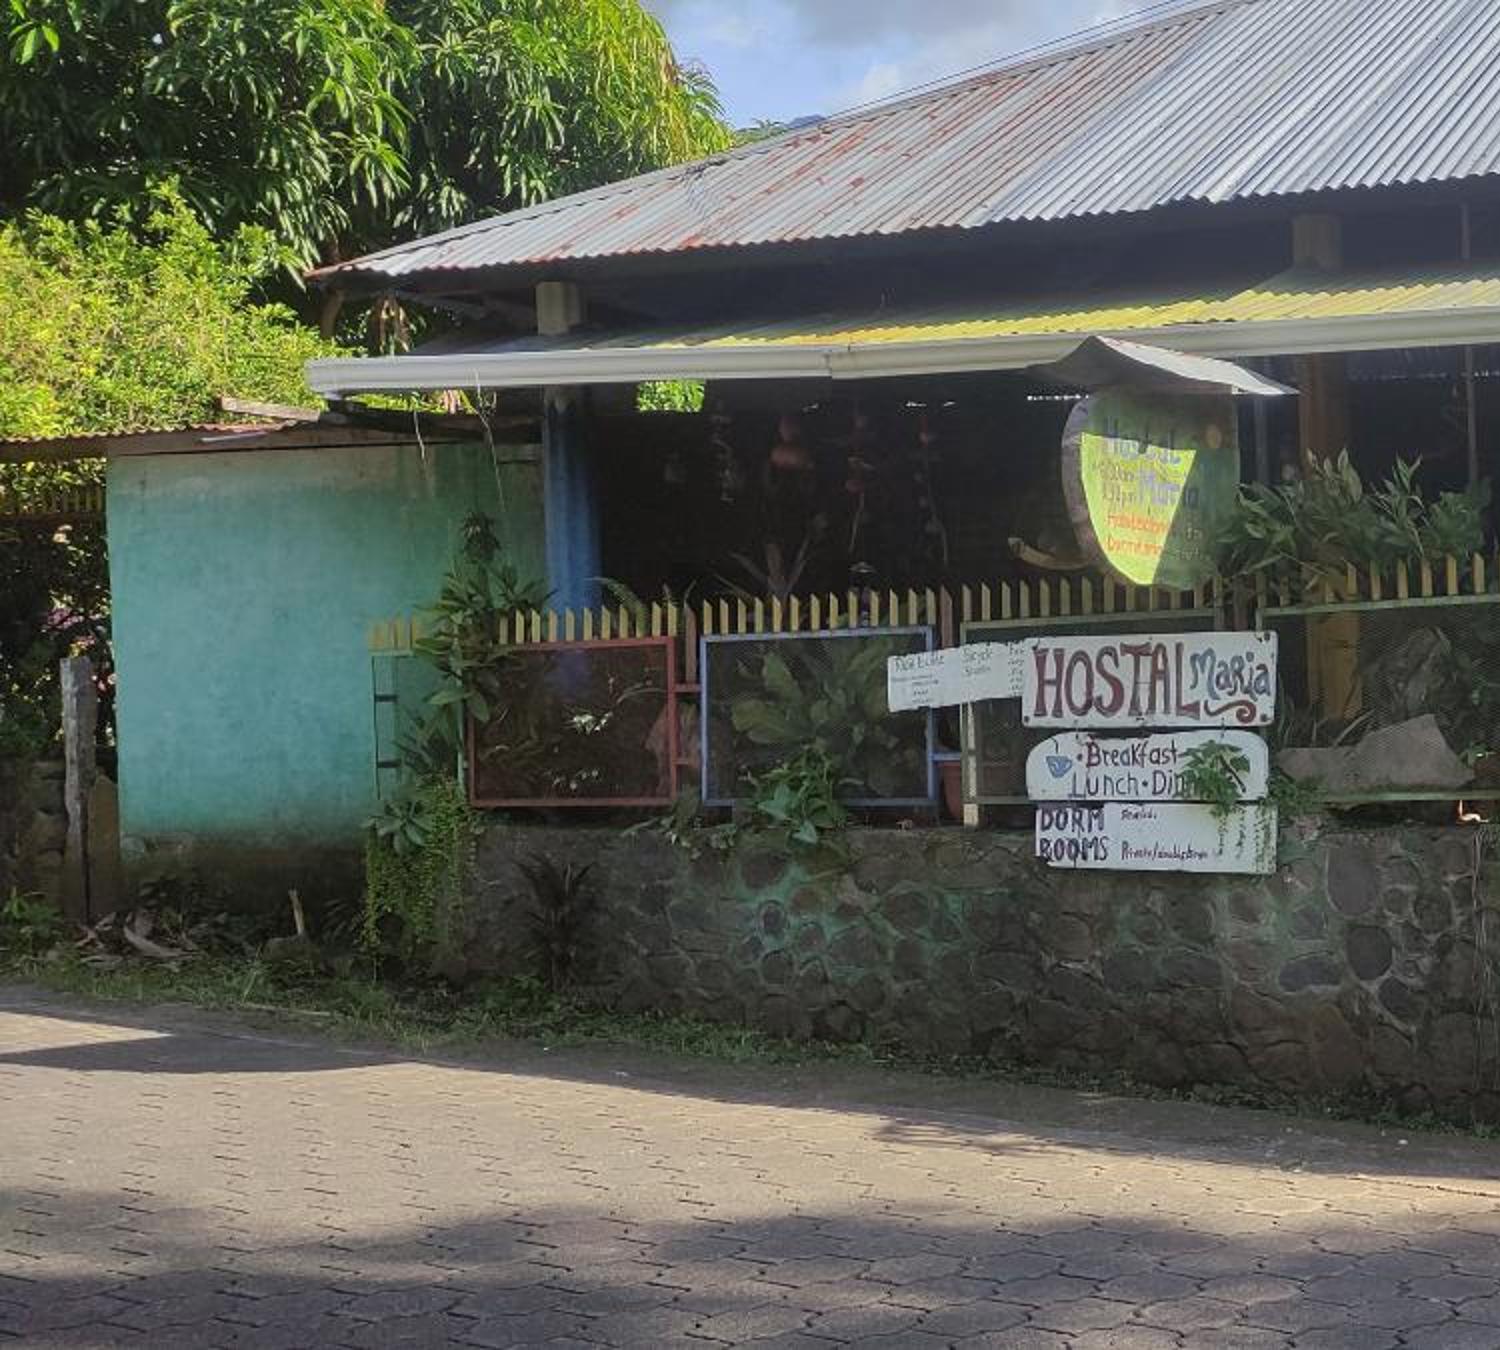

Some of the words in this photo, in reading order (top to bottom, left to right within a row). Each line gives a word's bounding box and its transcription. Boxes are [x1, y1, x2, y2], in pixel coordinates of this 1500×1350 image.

[1033, 641, 1200, 719] HOSTAL
[1085, 740, 1180, 769] Breakfast
[1068, 771, 1139, 799] Lunch
[1039, 807, 1106, 833] DORM
[1039, 836, 1110, 863] ROOMS
